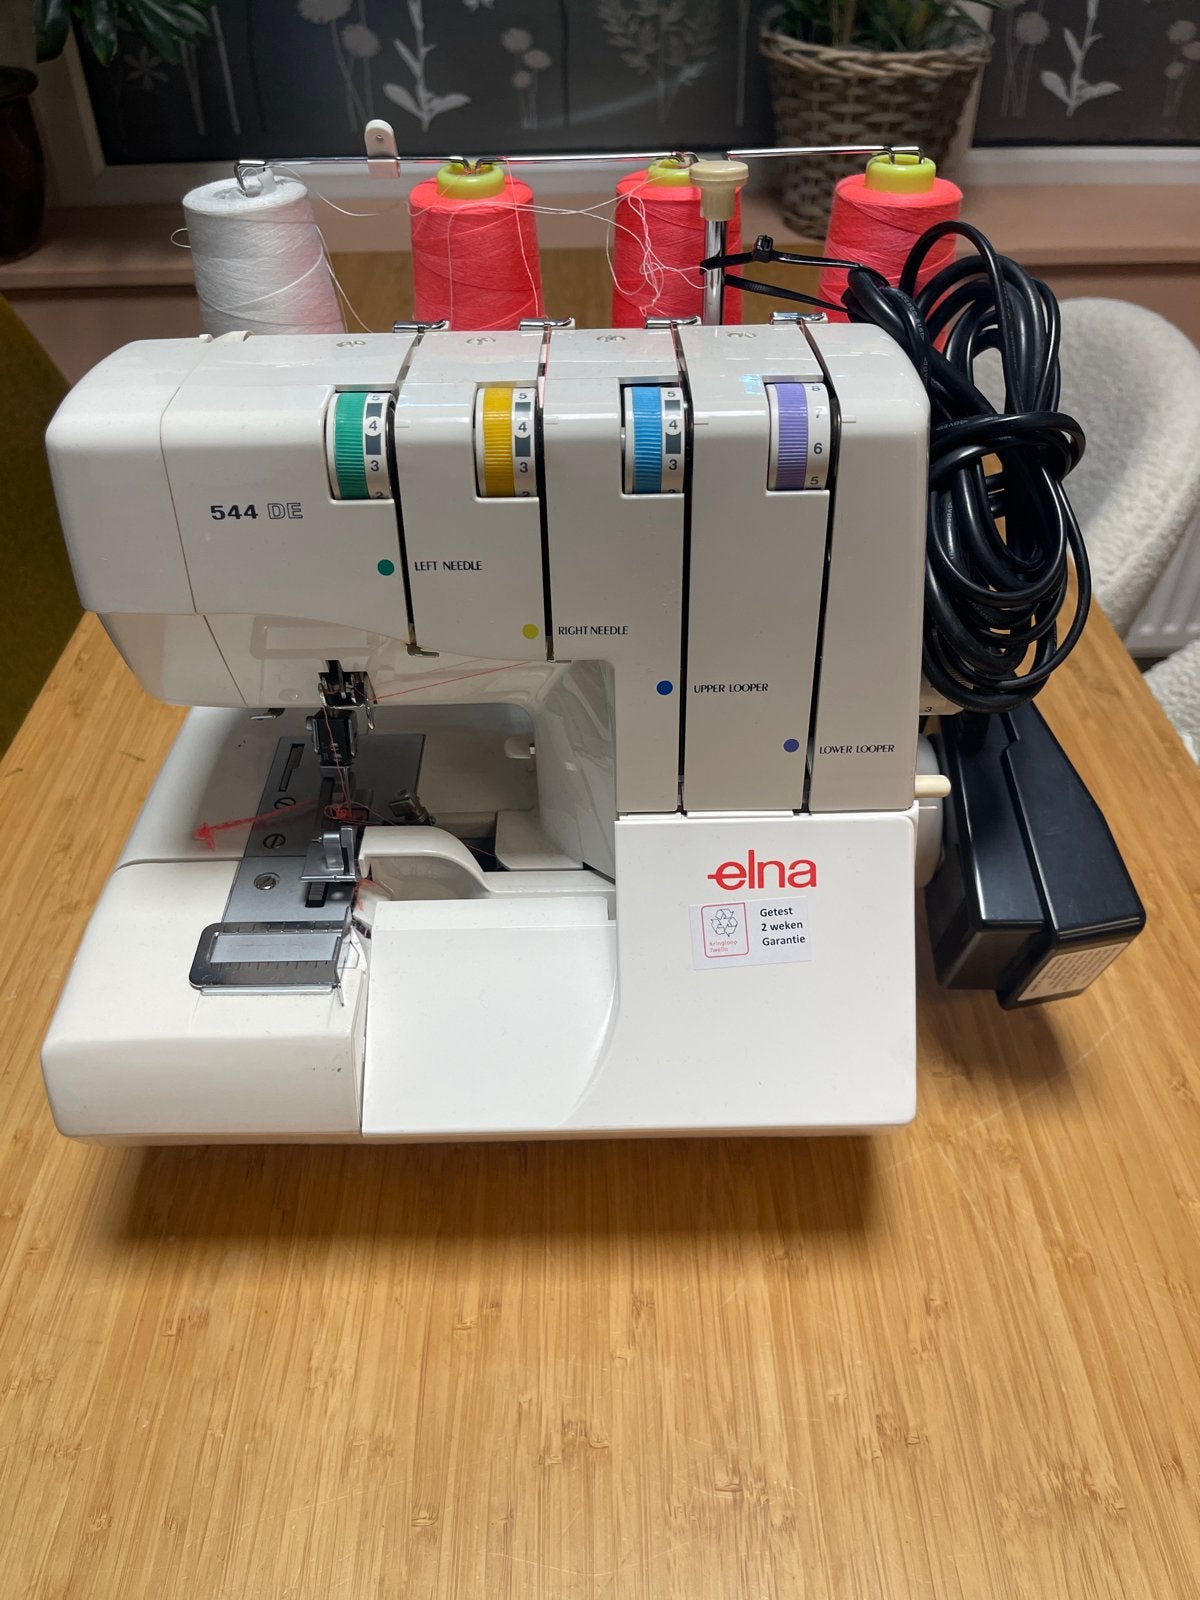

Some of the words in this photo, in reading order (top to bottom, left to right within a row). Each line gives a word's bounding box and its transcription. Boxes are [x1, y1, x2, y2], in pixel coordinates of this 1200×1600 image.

[667, 390, 676, 398] 5
[369, 420, 378, 431] 4
[518, 422, 528, 432] 4
[669, 420, 678, 430] 4
[813, 442, 823, 454] 6
[370, 460, 380, 471] 3
[520, 461, 529, 473] 3
[668, 458, 678, 470] 3
[810, 476, 819, 485] 5
[210, 504, 258, 520] 544
[267, 502, 304, 520] DE
[414, 560, 438, 571] LEFT
[442, 560, 483, 571] NEEDLE
[557, 625, 588, 636] RIGHT
[590, 625, 629, 636] NEEDLE
[693, 684, 725, 694] UPPER
[728, 683, 769, 693] LOOPER
[819, 745, 853, 755] LOWER
[856, 744, 895, 754] LOOPER
[707, 849, 817, 891] elna
[759, 906, 794, 918] Getest
[761, 923, 768, 932] 2
[769, 920, 803, 931] weken
[762, 934, 806, 947] Garantie
